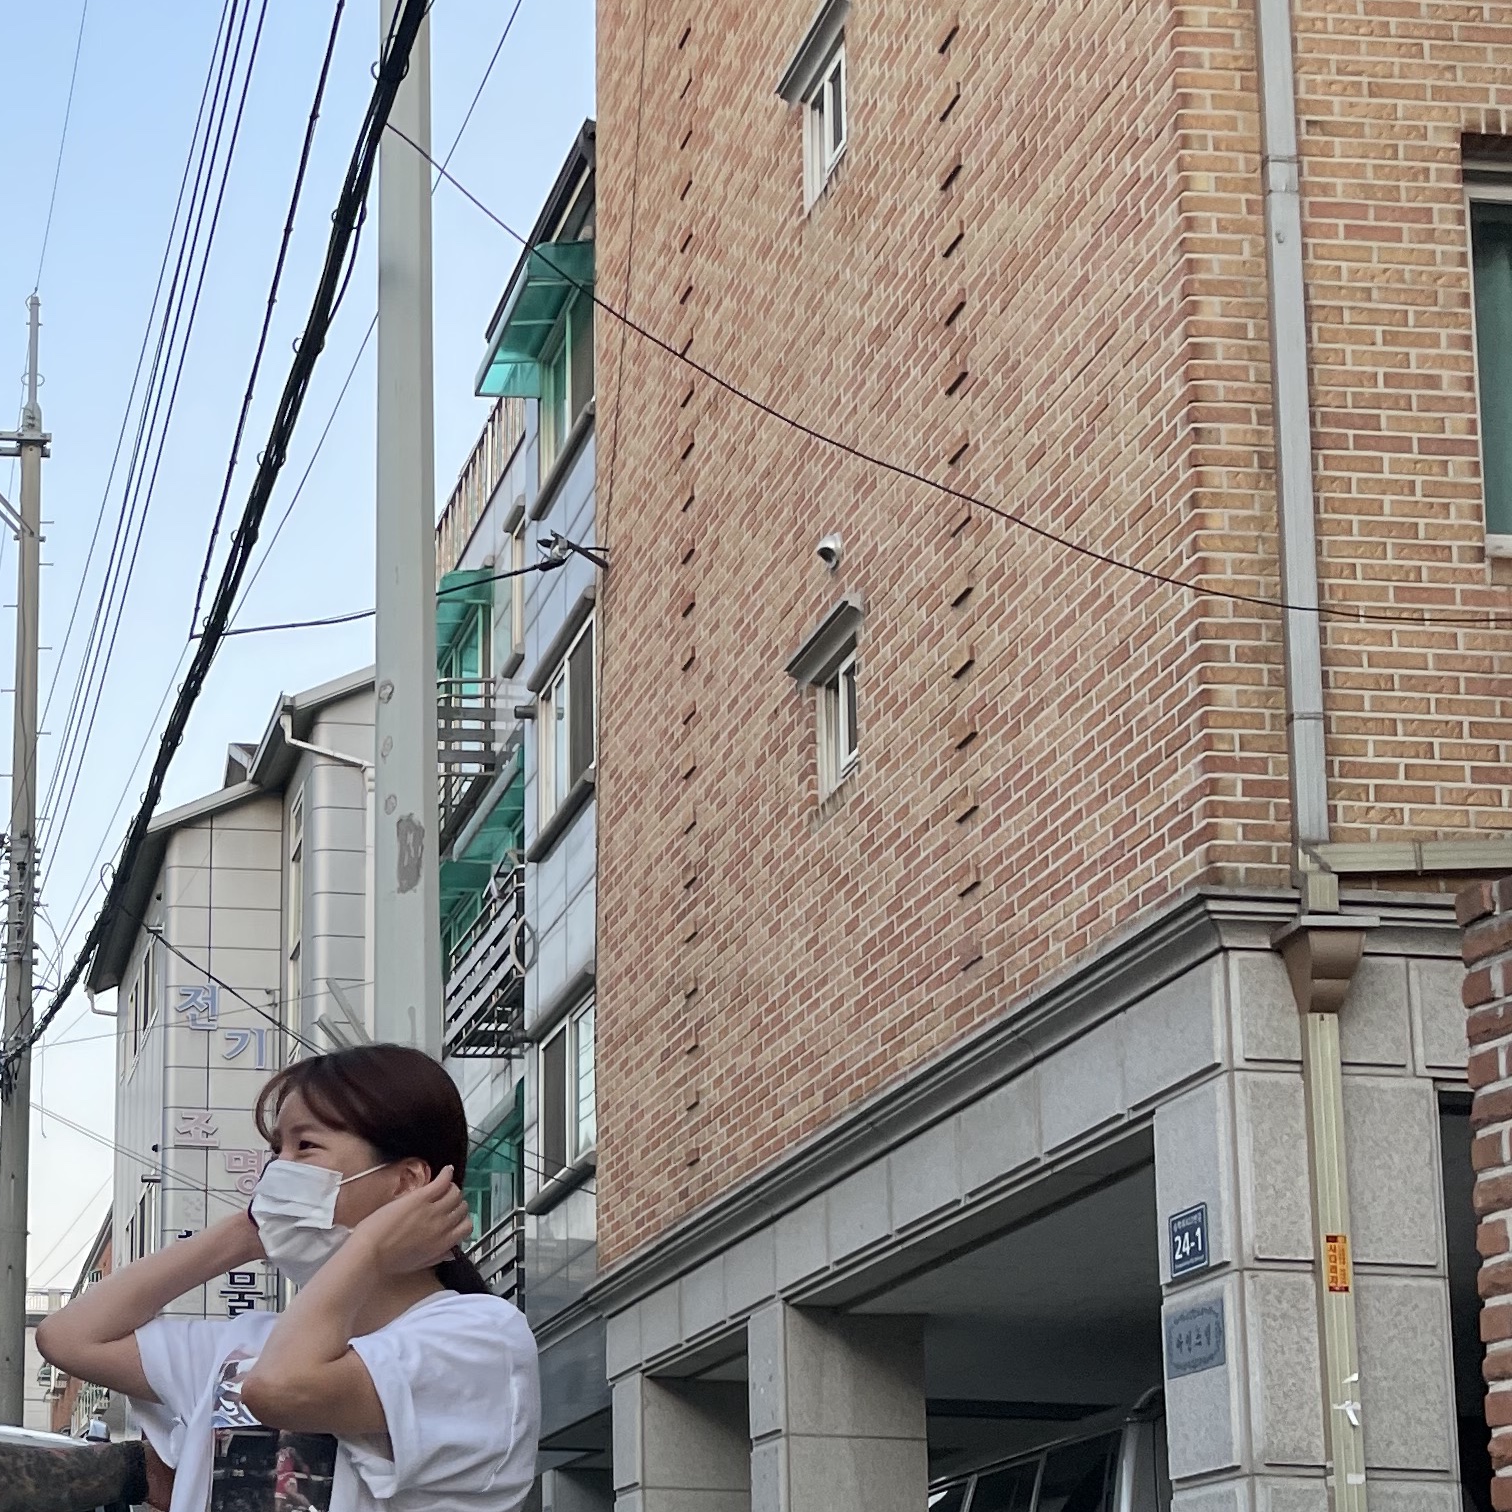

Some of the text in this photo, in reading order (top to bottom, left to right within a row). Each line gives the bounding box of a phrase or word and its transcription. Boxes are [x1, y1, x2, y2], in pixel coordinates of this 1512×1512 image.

[175, 984, 267, 1070] 전기
[174, 1111, 266, 1195] 조명
[1174, 1226, 1202, 1260] 24-1
